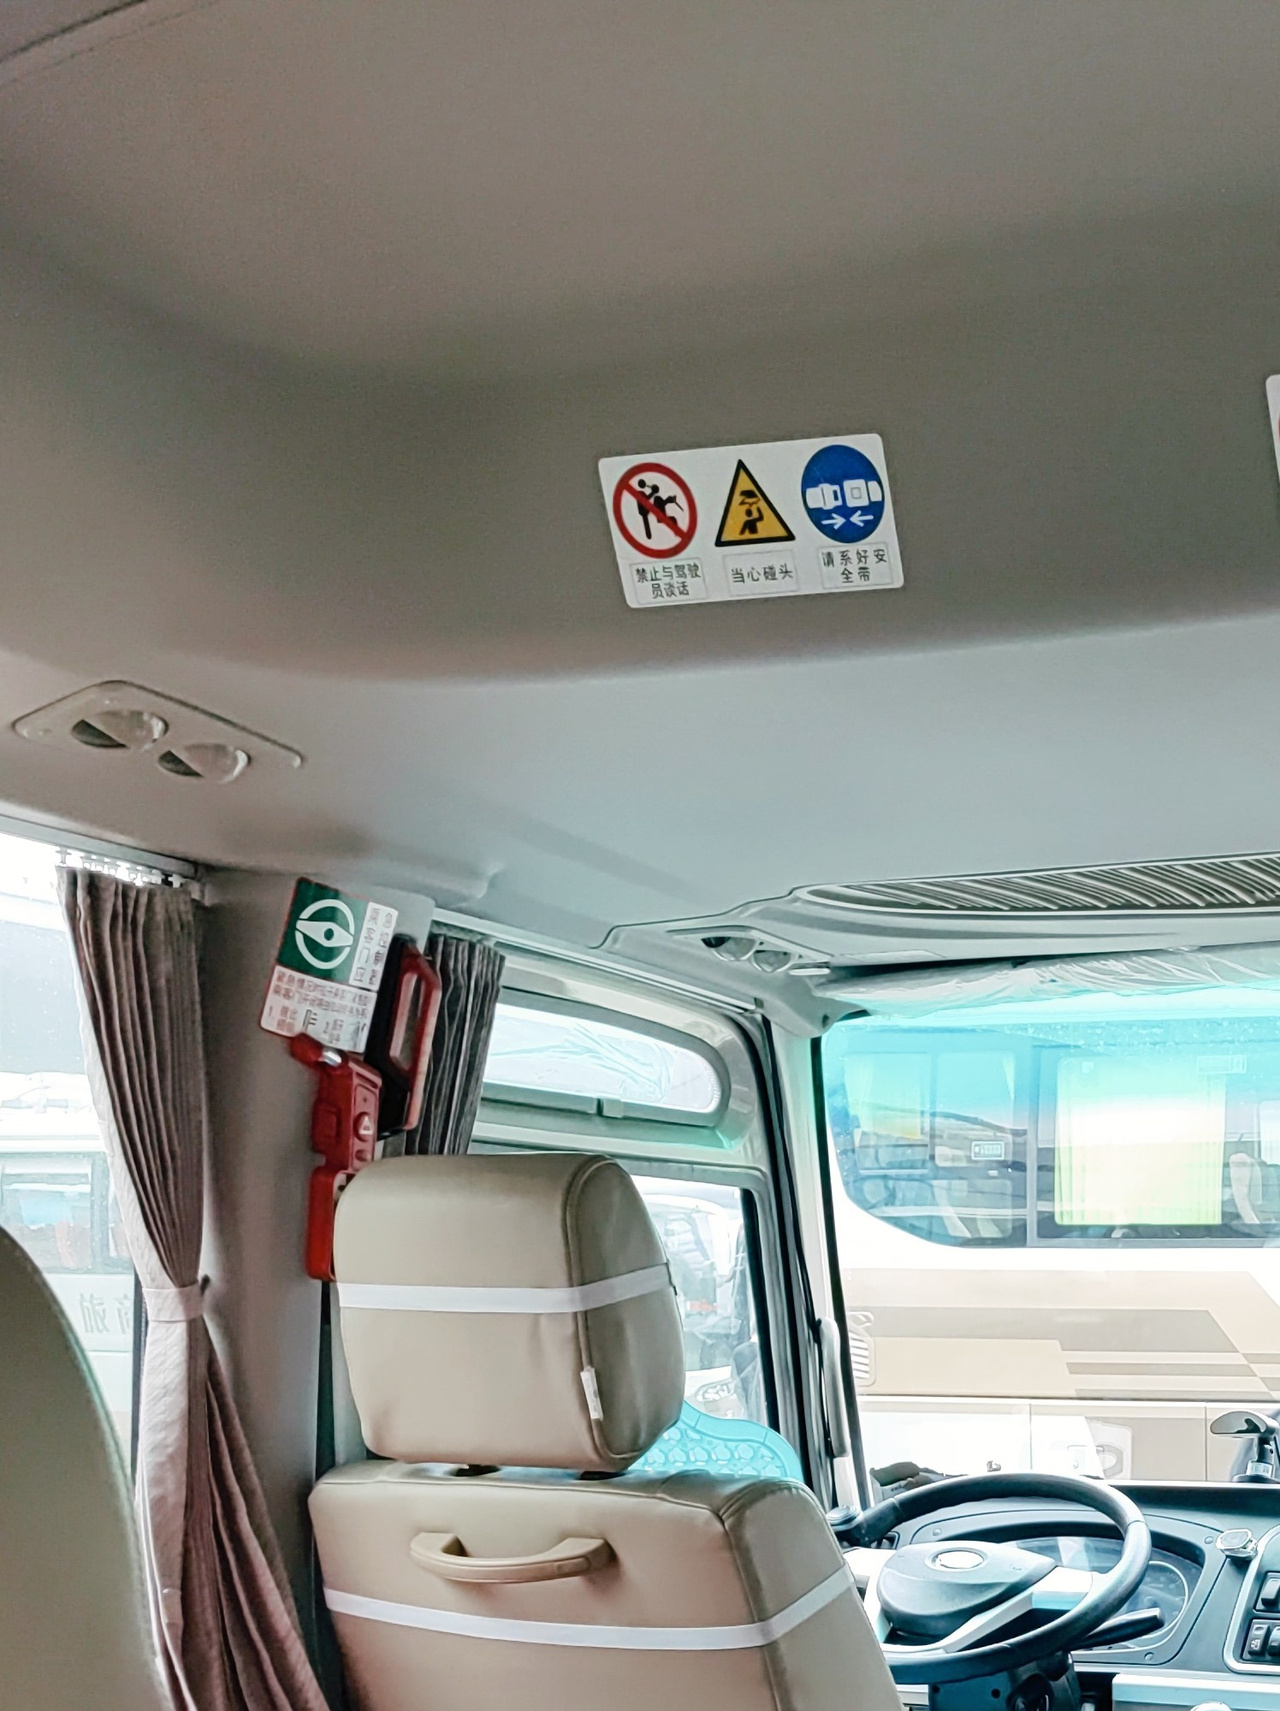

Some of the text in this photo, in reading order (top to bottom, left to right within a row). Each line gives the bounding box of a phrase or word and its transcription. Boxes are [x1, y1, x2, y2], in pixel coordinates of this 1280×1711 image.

[822, 548, 888, 568] 请系好安
[635, 562, 701, 583] 禁止与驾驶
[731, 563, 794, 584] 当心碰头
[840, 566, 871, 584] 全带
[651, 581, 690, 599] 员谈话
